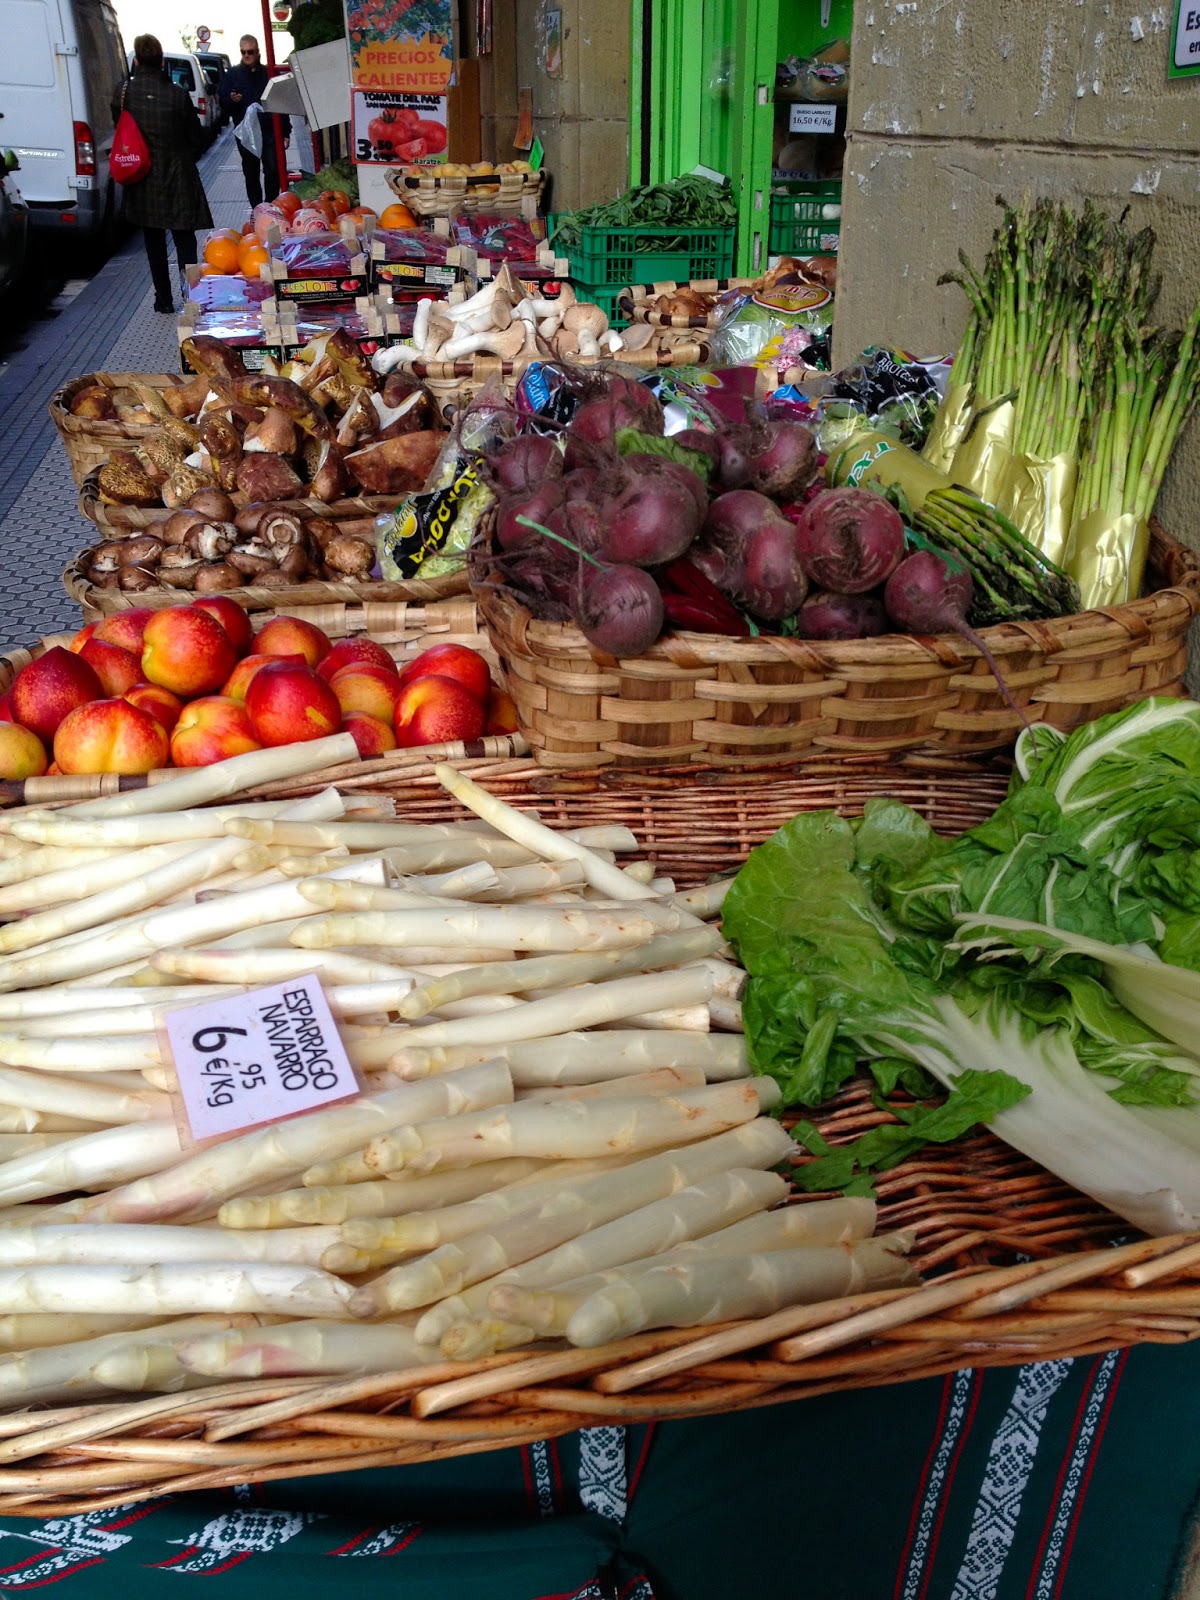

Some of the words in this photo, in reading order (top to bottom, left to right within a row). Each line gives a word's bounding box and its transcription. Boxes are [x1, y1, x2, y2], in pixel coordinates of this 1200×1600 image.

[366, 51, 436, 65] PRECIOS
[357, 72, 447, 86] CALIENTES
[363, 92, 401, 102] TOMATE
[403, 94, 420, 103] DEL
[283, 988, 339, 1090] ESPARRAGO
[259, 1003, 309, 1091] NAVARRO
